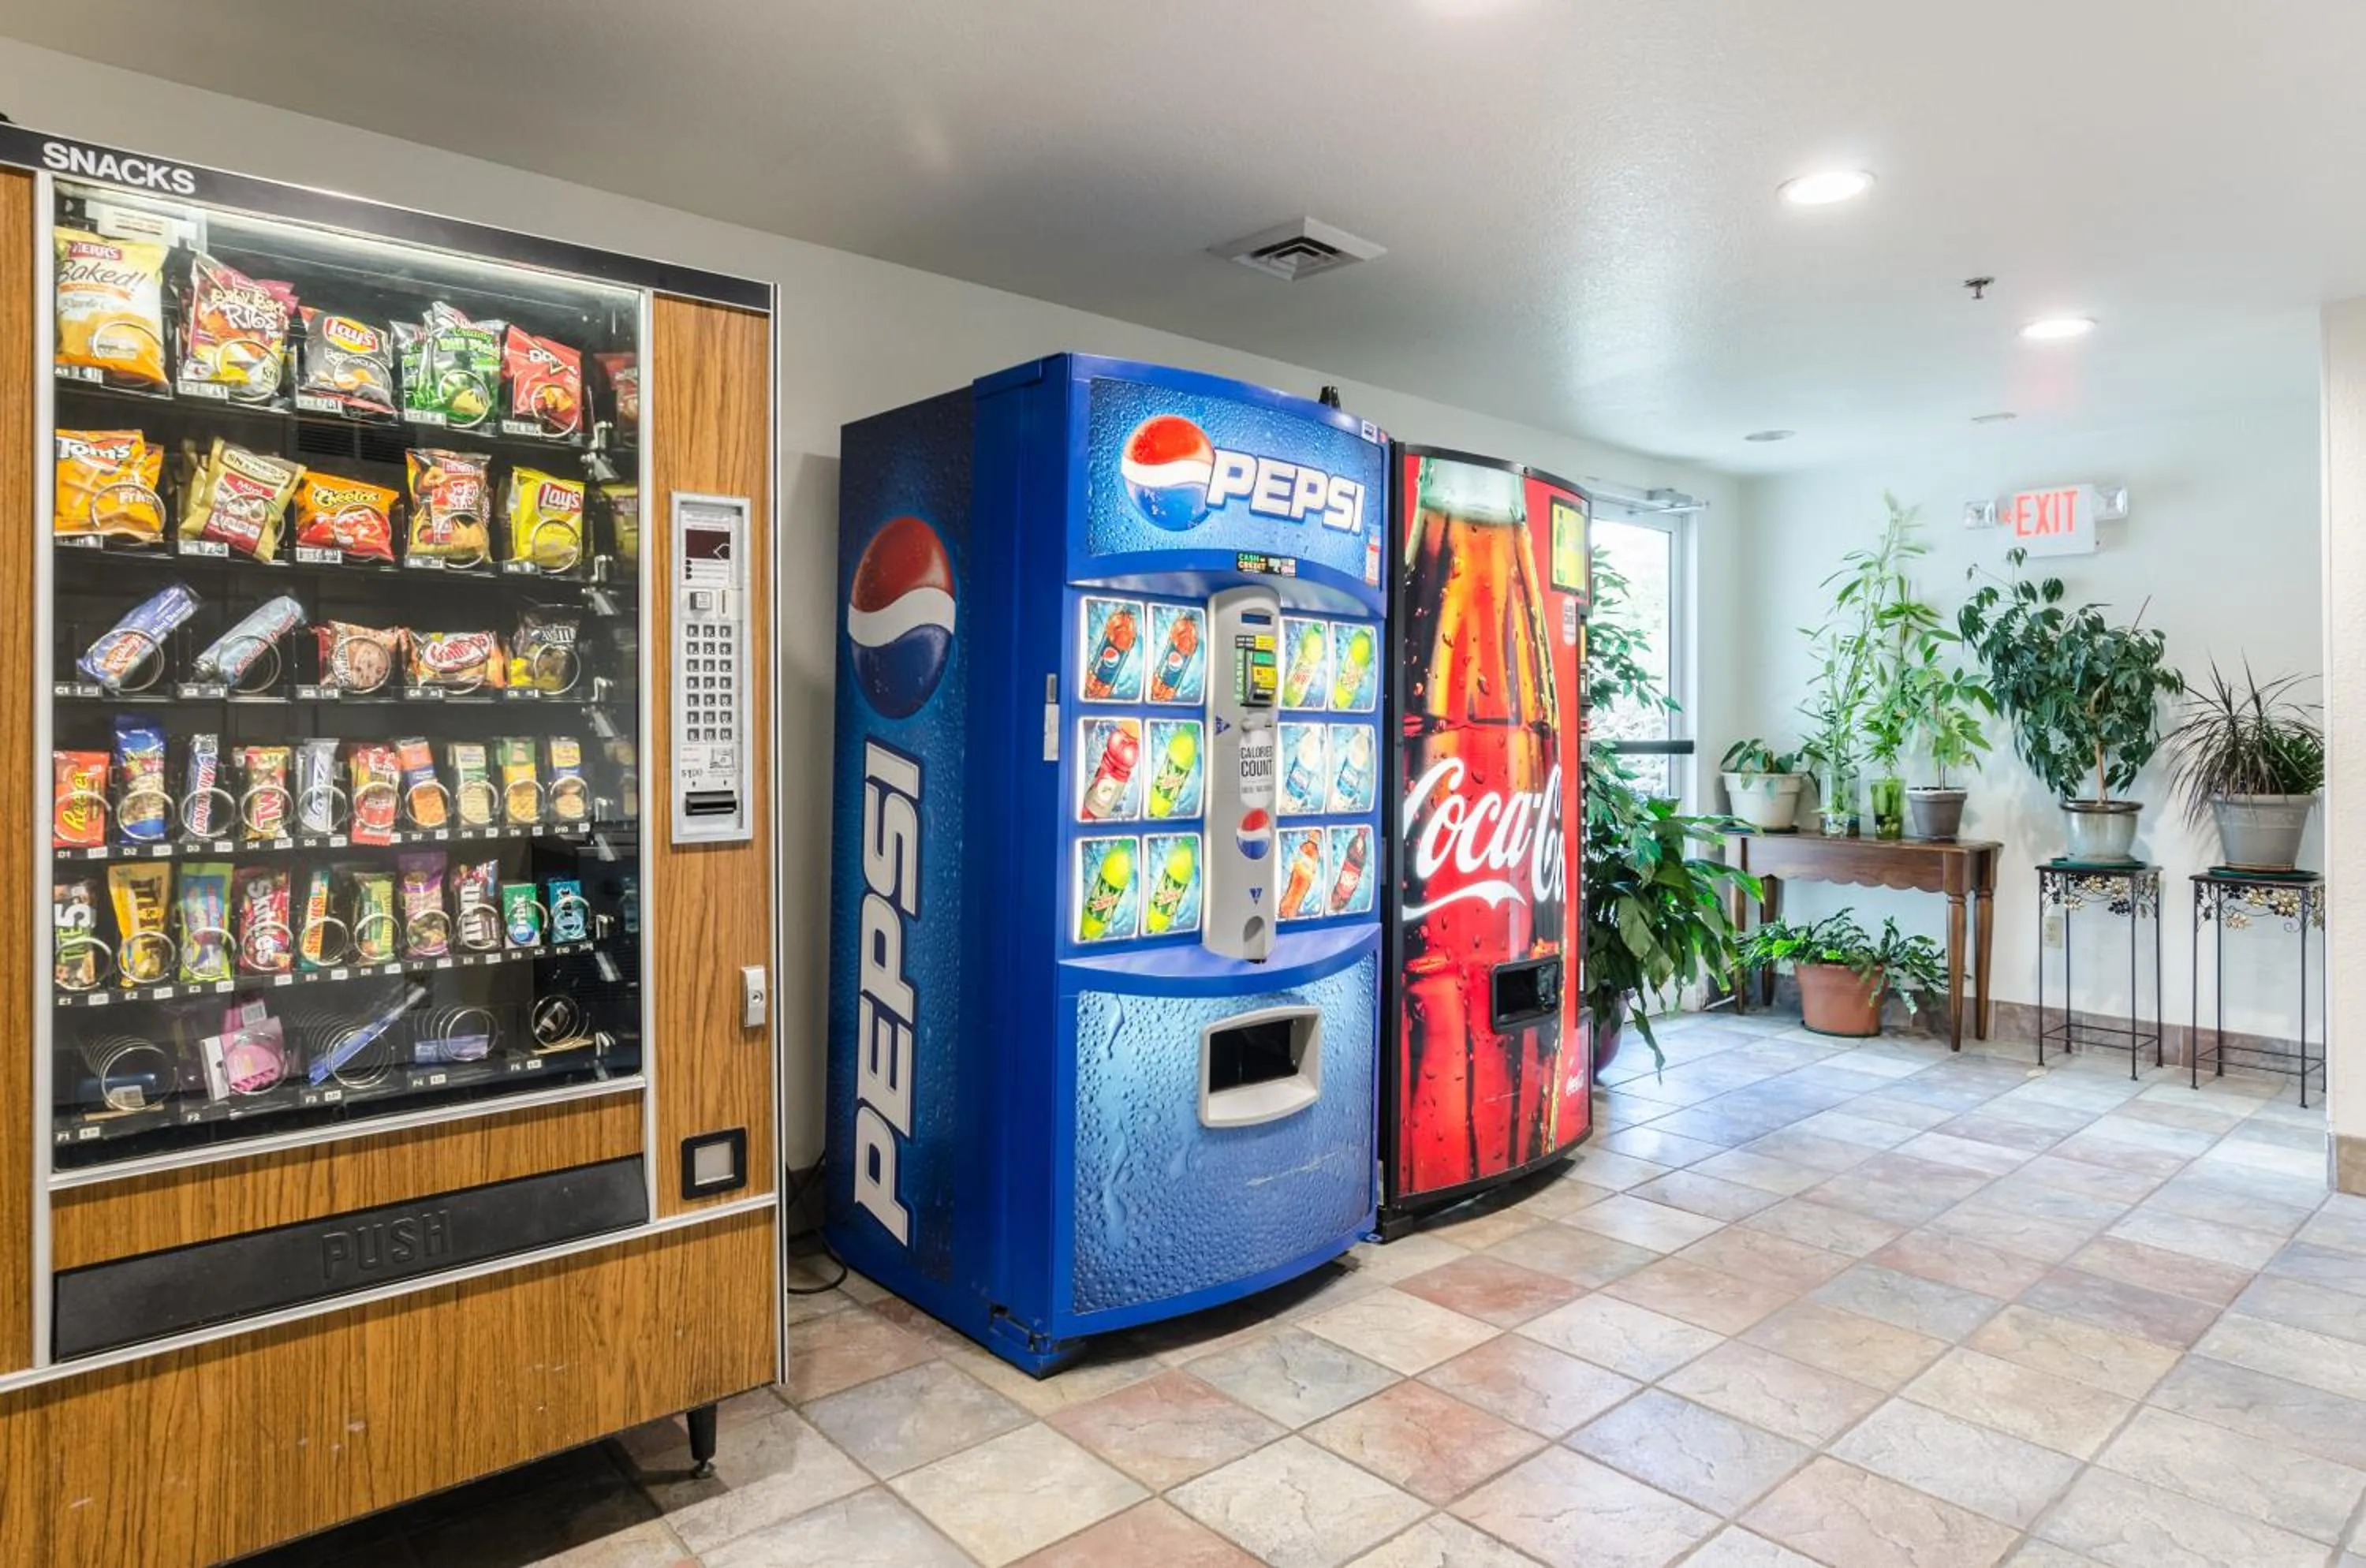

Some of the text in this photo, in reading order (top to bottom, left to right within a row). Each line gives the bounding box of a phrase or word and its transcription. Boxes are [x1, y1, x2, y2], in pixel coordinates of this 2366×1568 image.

[43, 142, 196, 195] SNACKS
[541, 483, 580, 512] Lay's
[1207, 447, 1366, 536] PEPSI
[2016, 490, 2078, 537] EXIT
[1241, 760, 1272, 777] COUNT
[123, 847, 138, 857] D2
[854, 741, 920, 1249] PEPSI
[321, 1208, 452, 1280] PUSH
